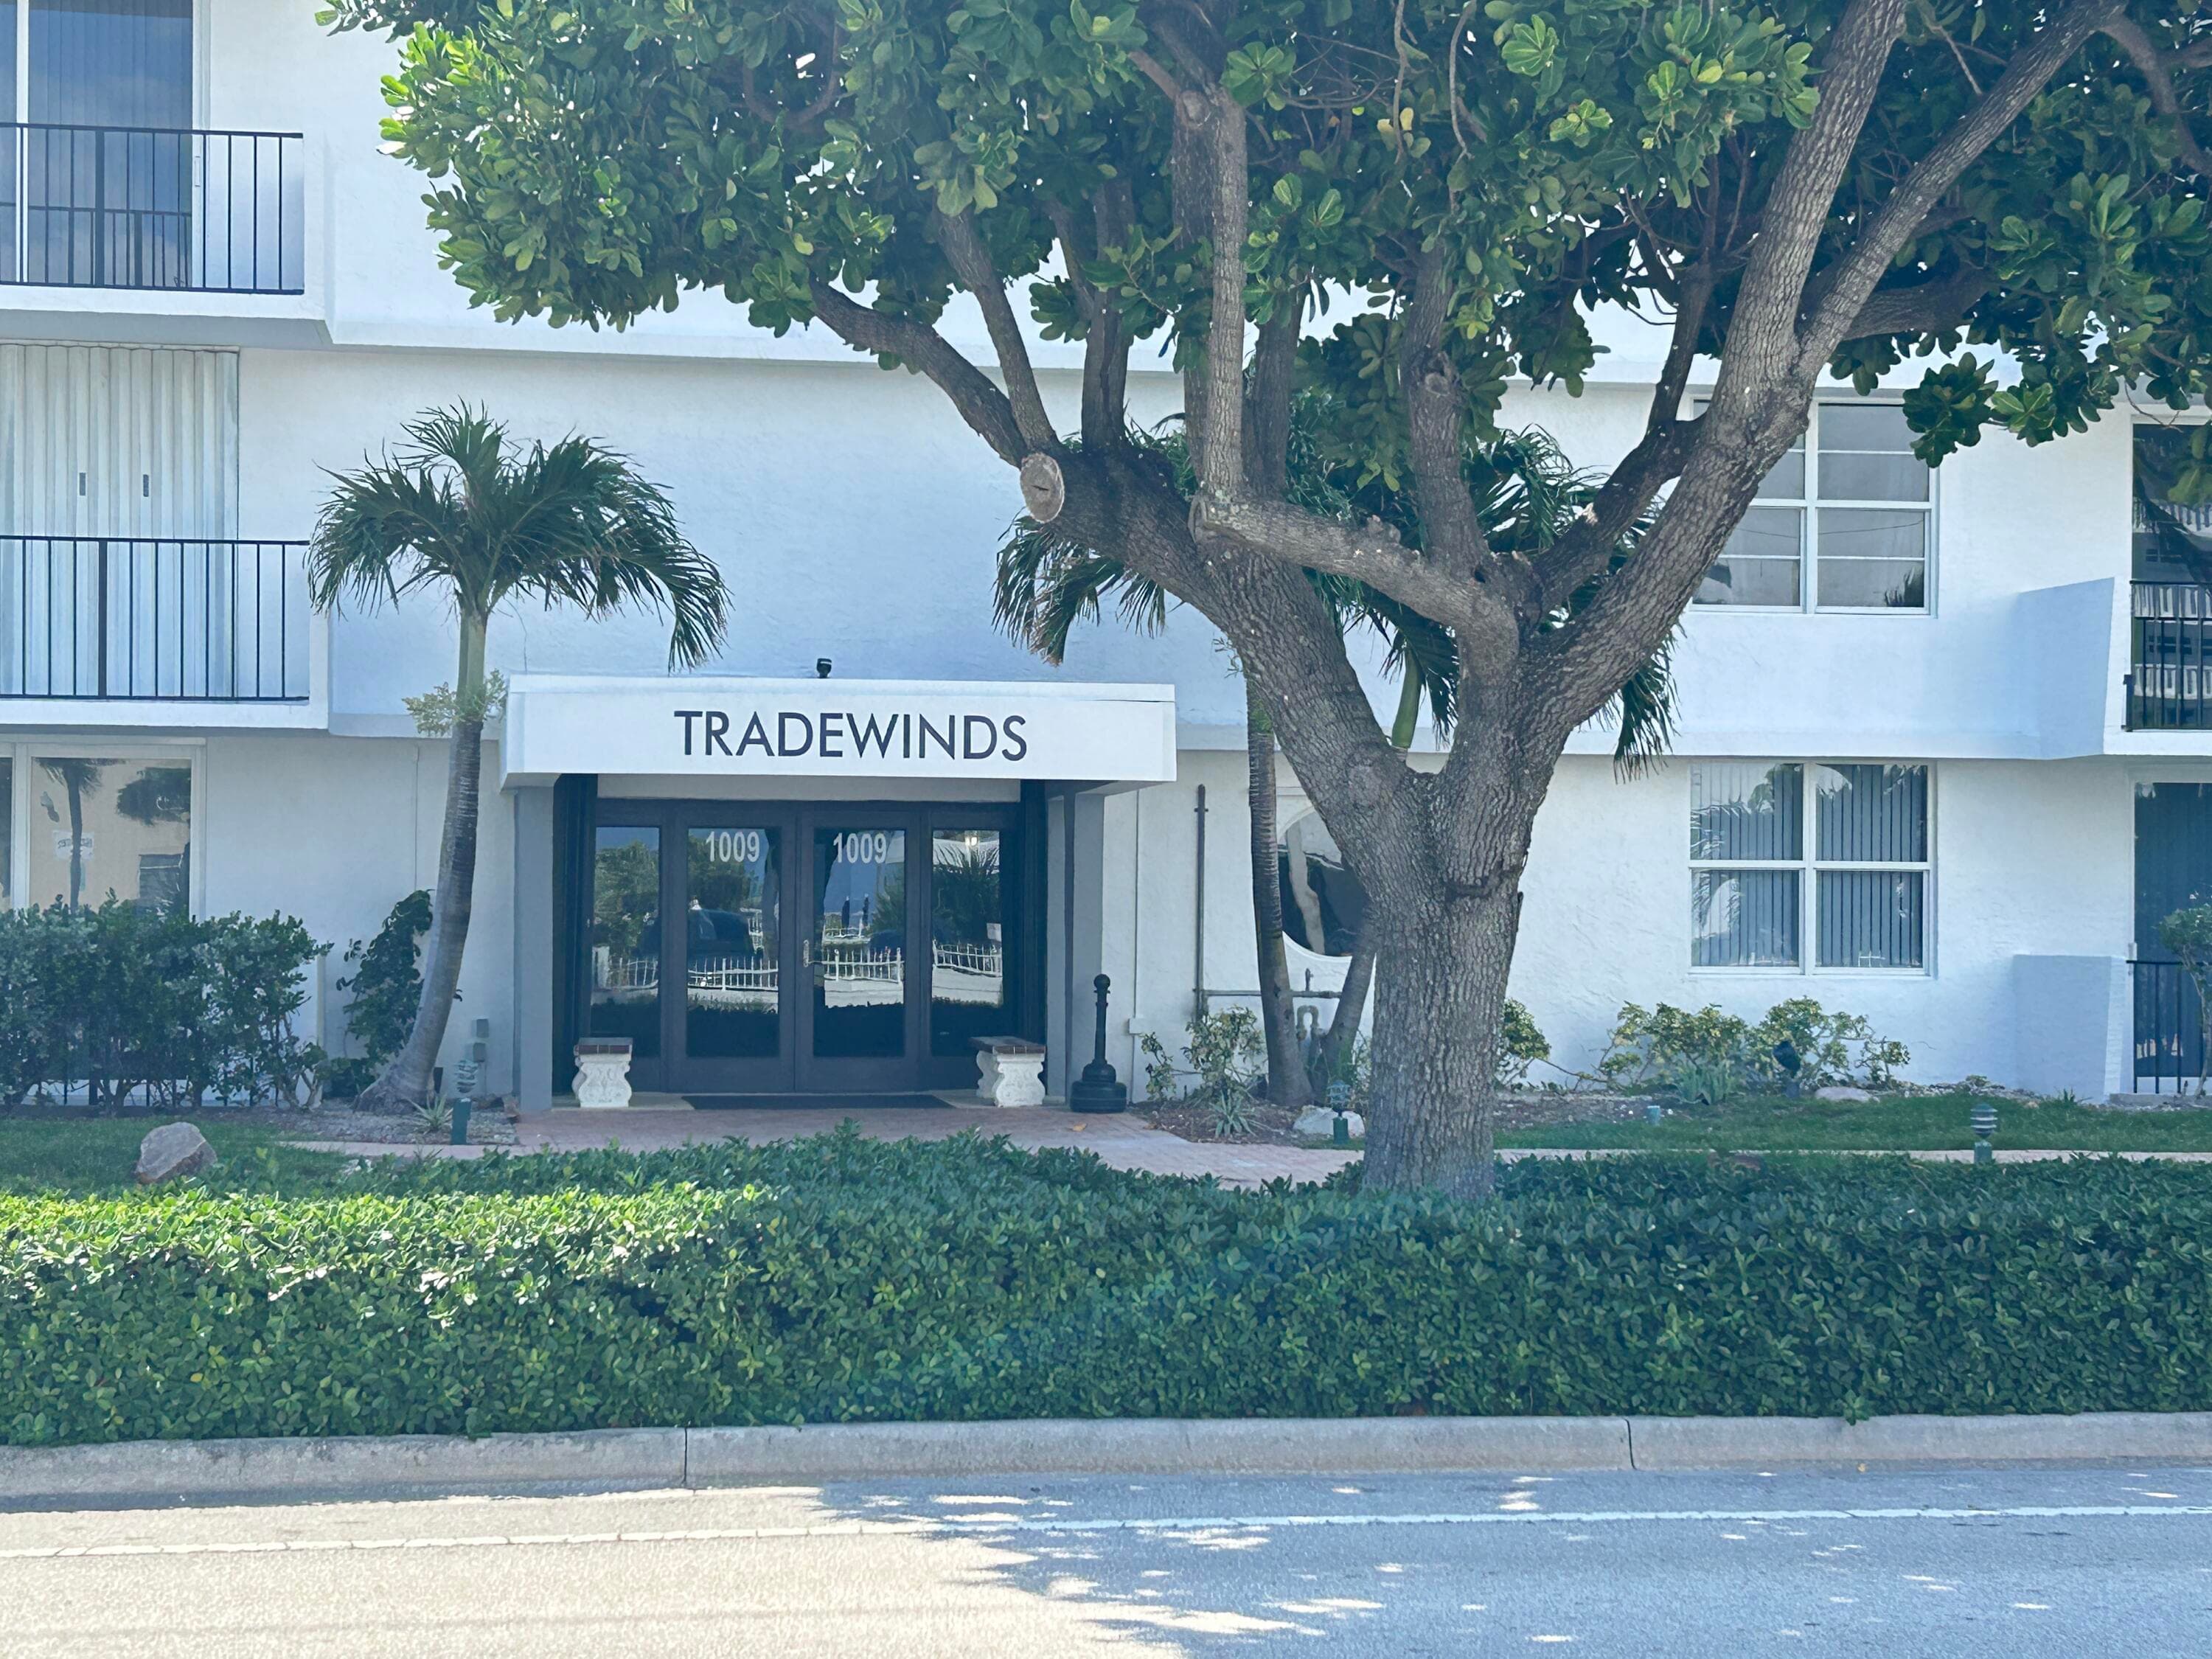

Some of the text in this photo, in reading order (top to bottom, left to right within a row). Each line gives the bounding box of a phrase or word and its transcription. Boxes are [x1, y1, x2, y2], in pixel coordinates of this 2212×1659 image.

[674, 711, 1028, 761] TRADEWINDS
[706, 831, 760, 862] 1009
[833, 832, 886, 863] 1009
